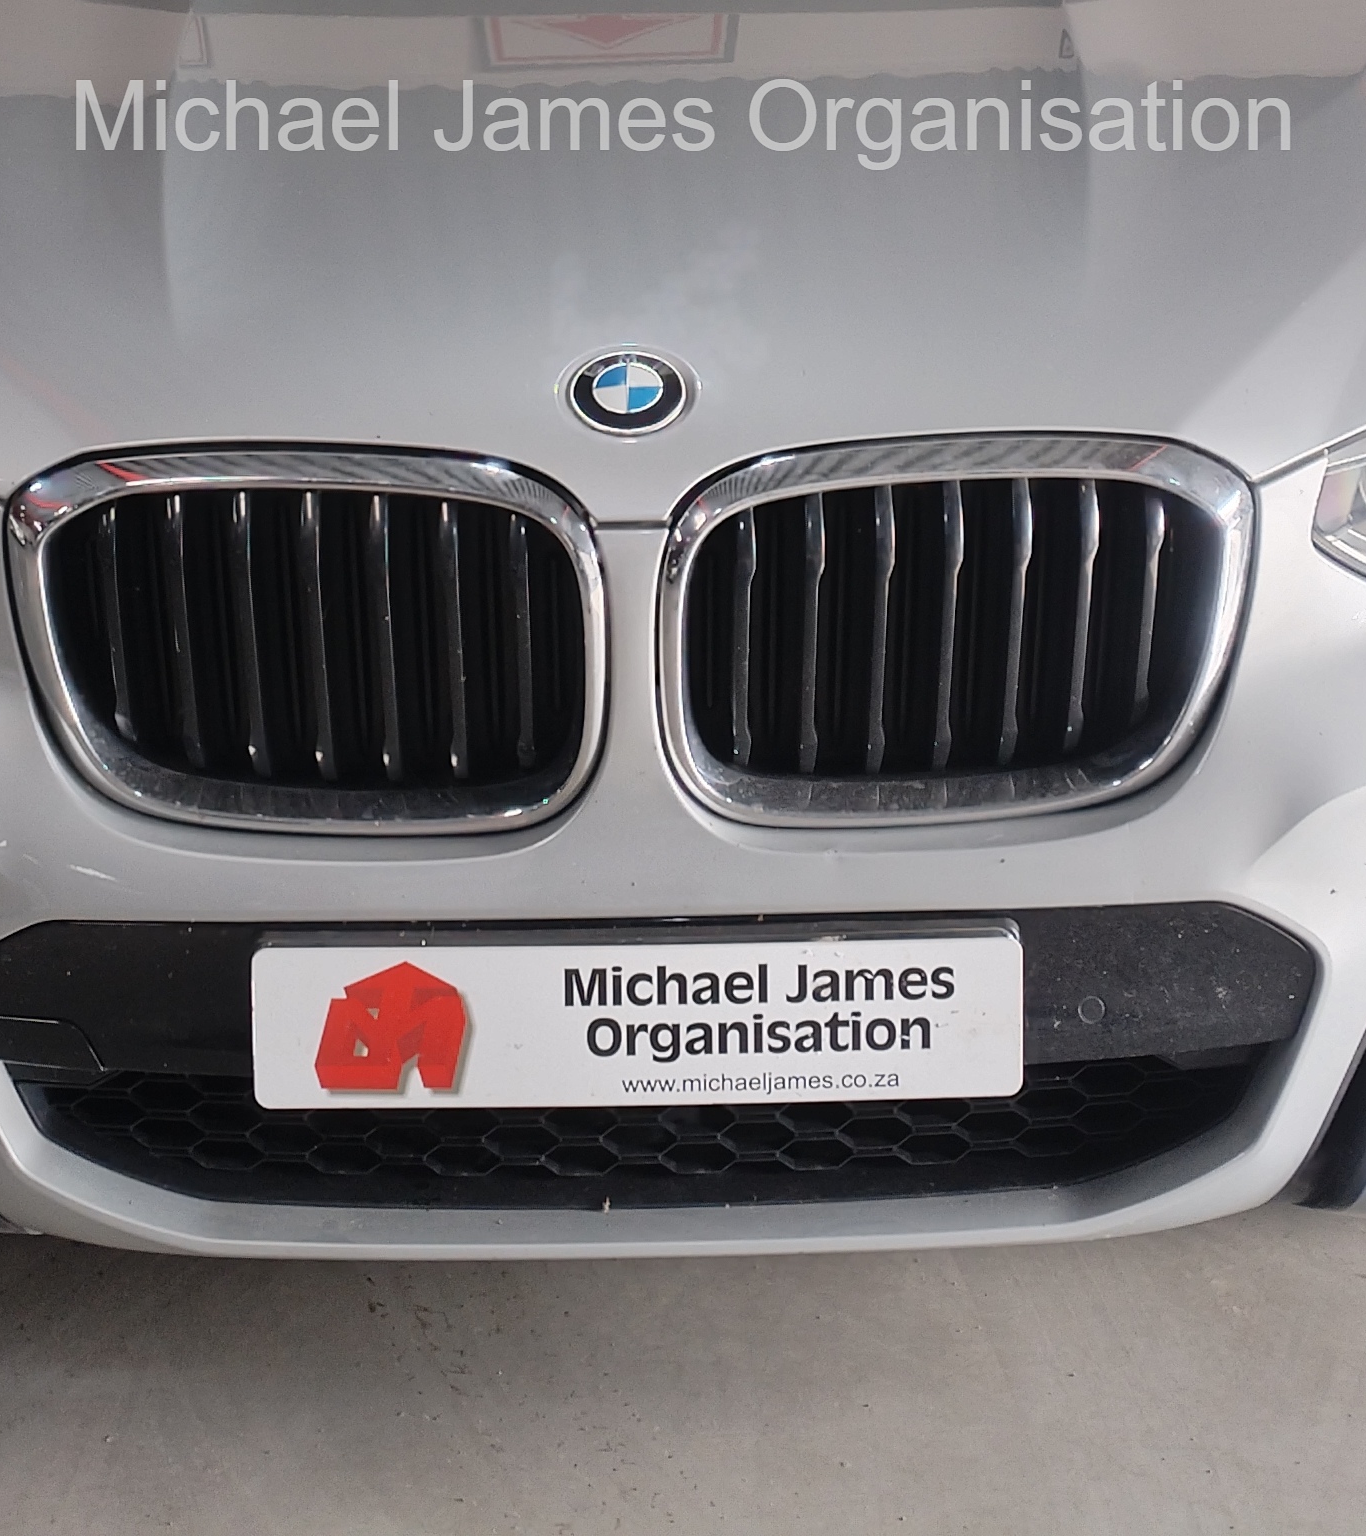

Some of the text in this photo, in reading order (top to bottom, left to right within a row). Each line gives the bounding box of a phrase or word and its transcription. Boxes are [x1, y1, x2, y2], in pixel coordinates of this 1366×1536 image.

[564, 963, 955, 1007] Michael James
[586, 1011, 931, 1064] Organisation
[621, 1070, 901, 1096] www.michaeljames.co.za
